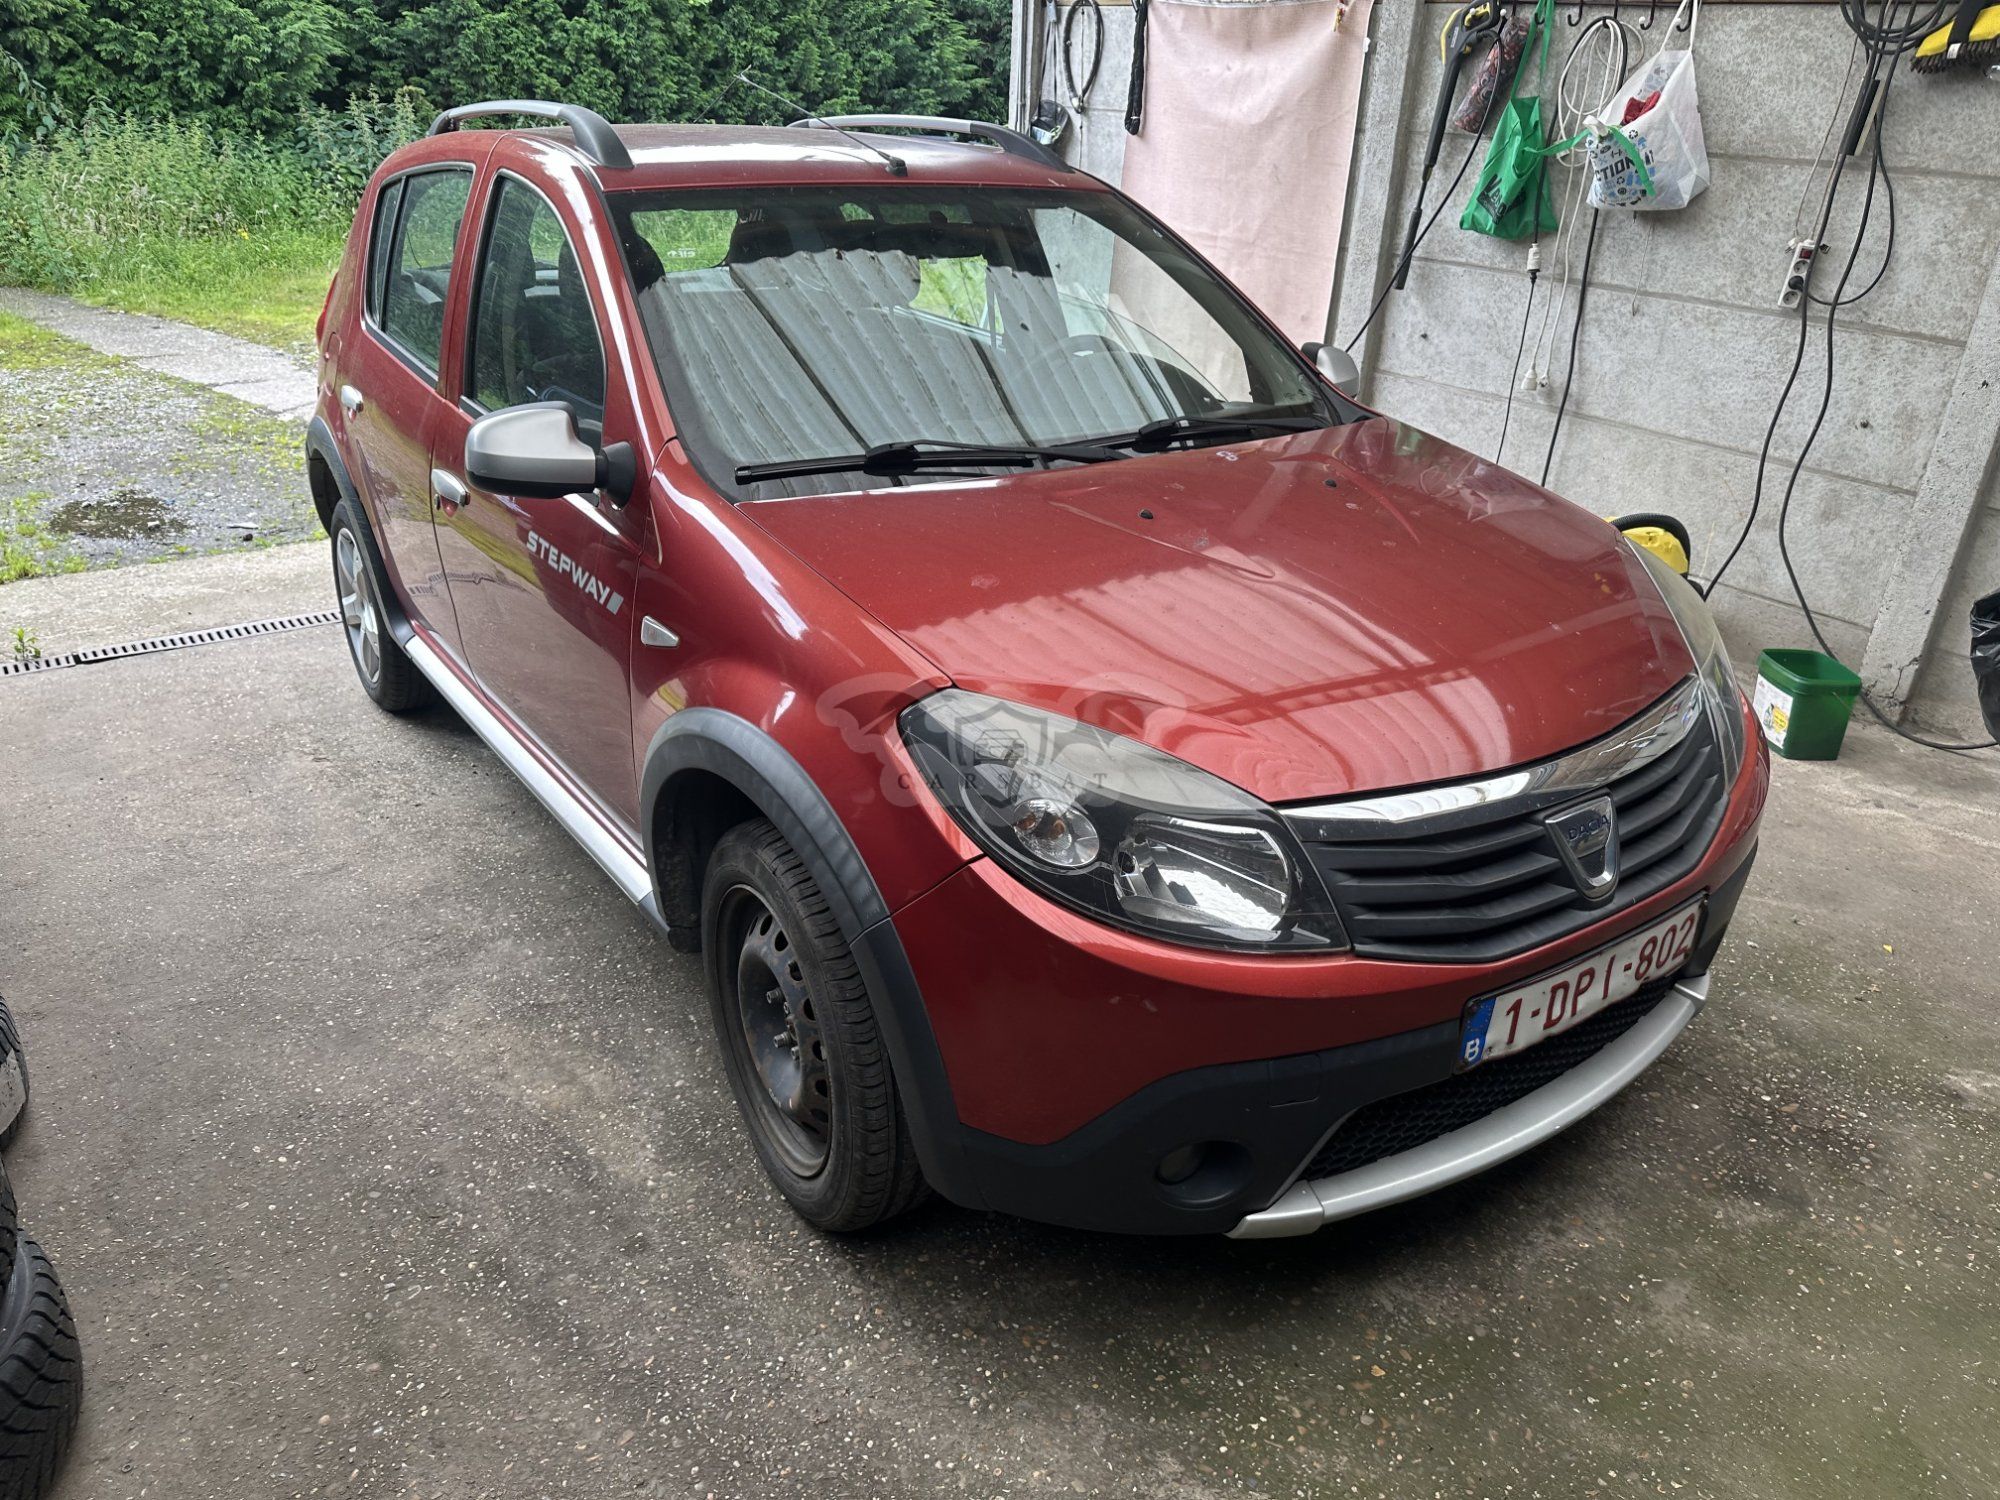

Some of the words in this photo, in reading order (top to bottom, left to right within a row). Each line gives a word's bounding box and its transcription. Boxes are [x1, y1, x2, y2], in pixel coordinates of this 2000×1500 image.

[526, 530, 611, 606] STEPWAY
[1568, 814, 1611, 839] DACIA
[1505, 912, 1696, 1045] 1-DPI-802
[1464, 1038, 1480, 1061] B
